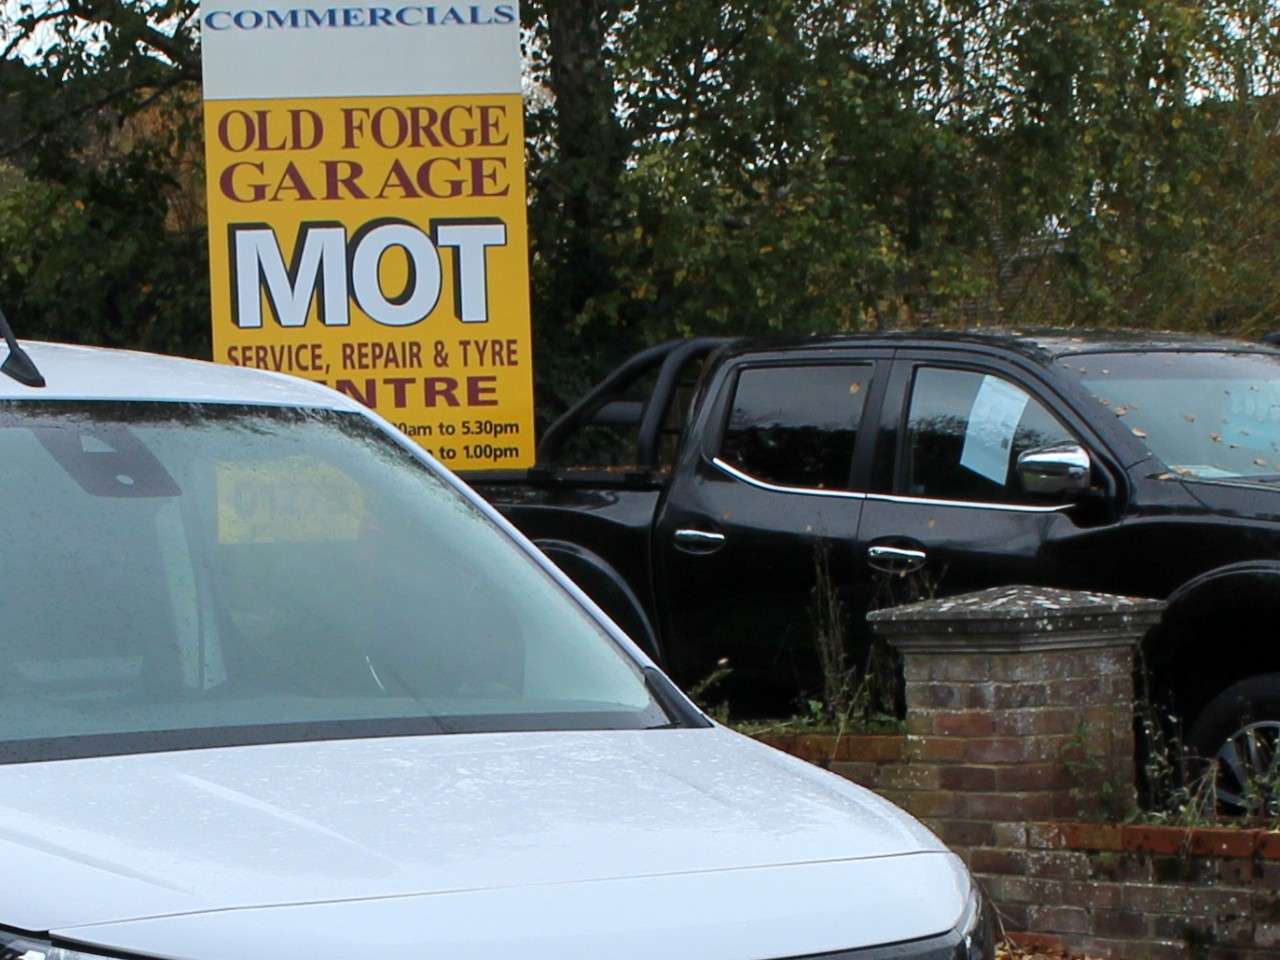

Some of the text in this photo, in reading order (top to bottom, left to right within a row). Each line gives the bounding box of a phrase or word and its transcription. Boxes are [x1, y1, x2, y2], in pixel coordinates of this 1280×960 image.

[204, 5, 516, 31] COMMERCIALS
[218, 104, 510, 152] OLD FORGE
[219, 156, 510, 203] GARAGE
[227, 217, 507, 329] MOT
[227, 338, 519, 374] SERVICE, REPAIR & TYRE
[438, 422, 455, 436] to
[461, 420, 520, 438] 5.30pm
[439, 446, 456, 460] to
[463, 444, 519, 462] 1.00pm
